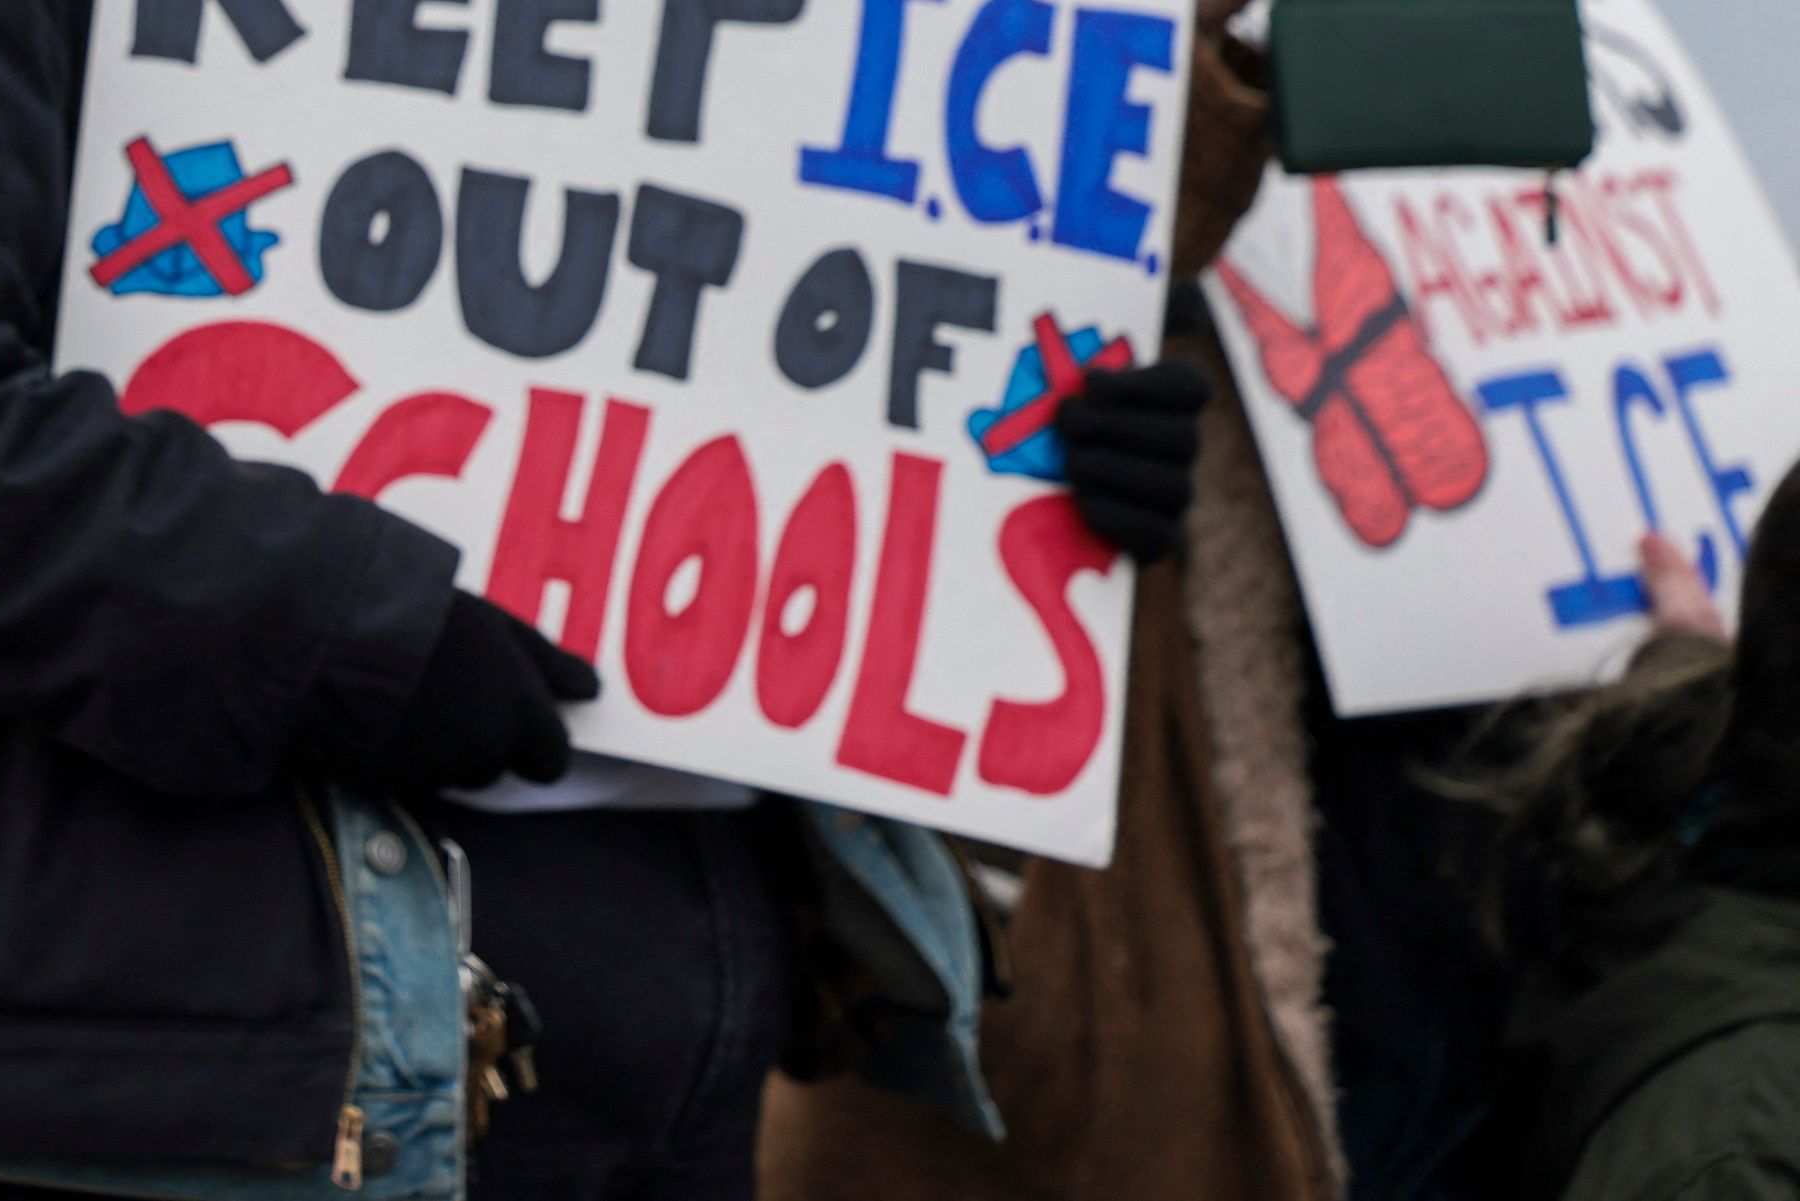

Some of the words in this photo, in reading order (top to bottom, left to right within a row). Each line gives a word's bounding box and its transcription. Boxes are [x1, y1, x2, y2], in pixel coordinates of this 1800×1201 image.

[318, 150, 744, 380] OUT
[774, 246, 999, 429] OF
[1393, 167, 1721, 347] AGAINST
